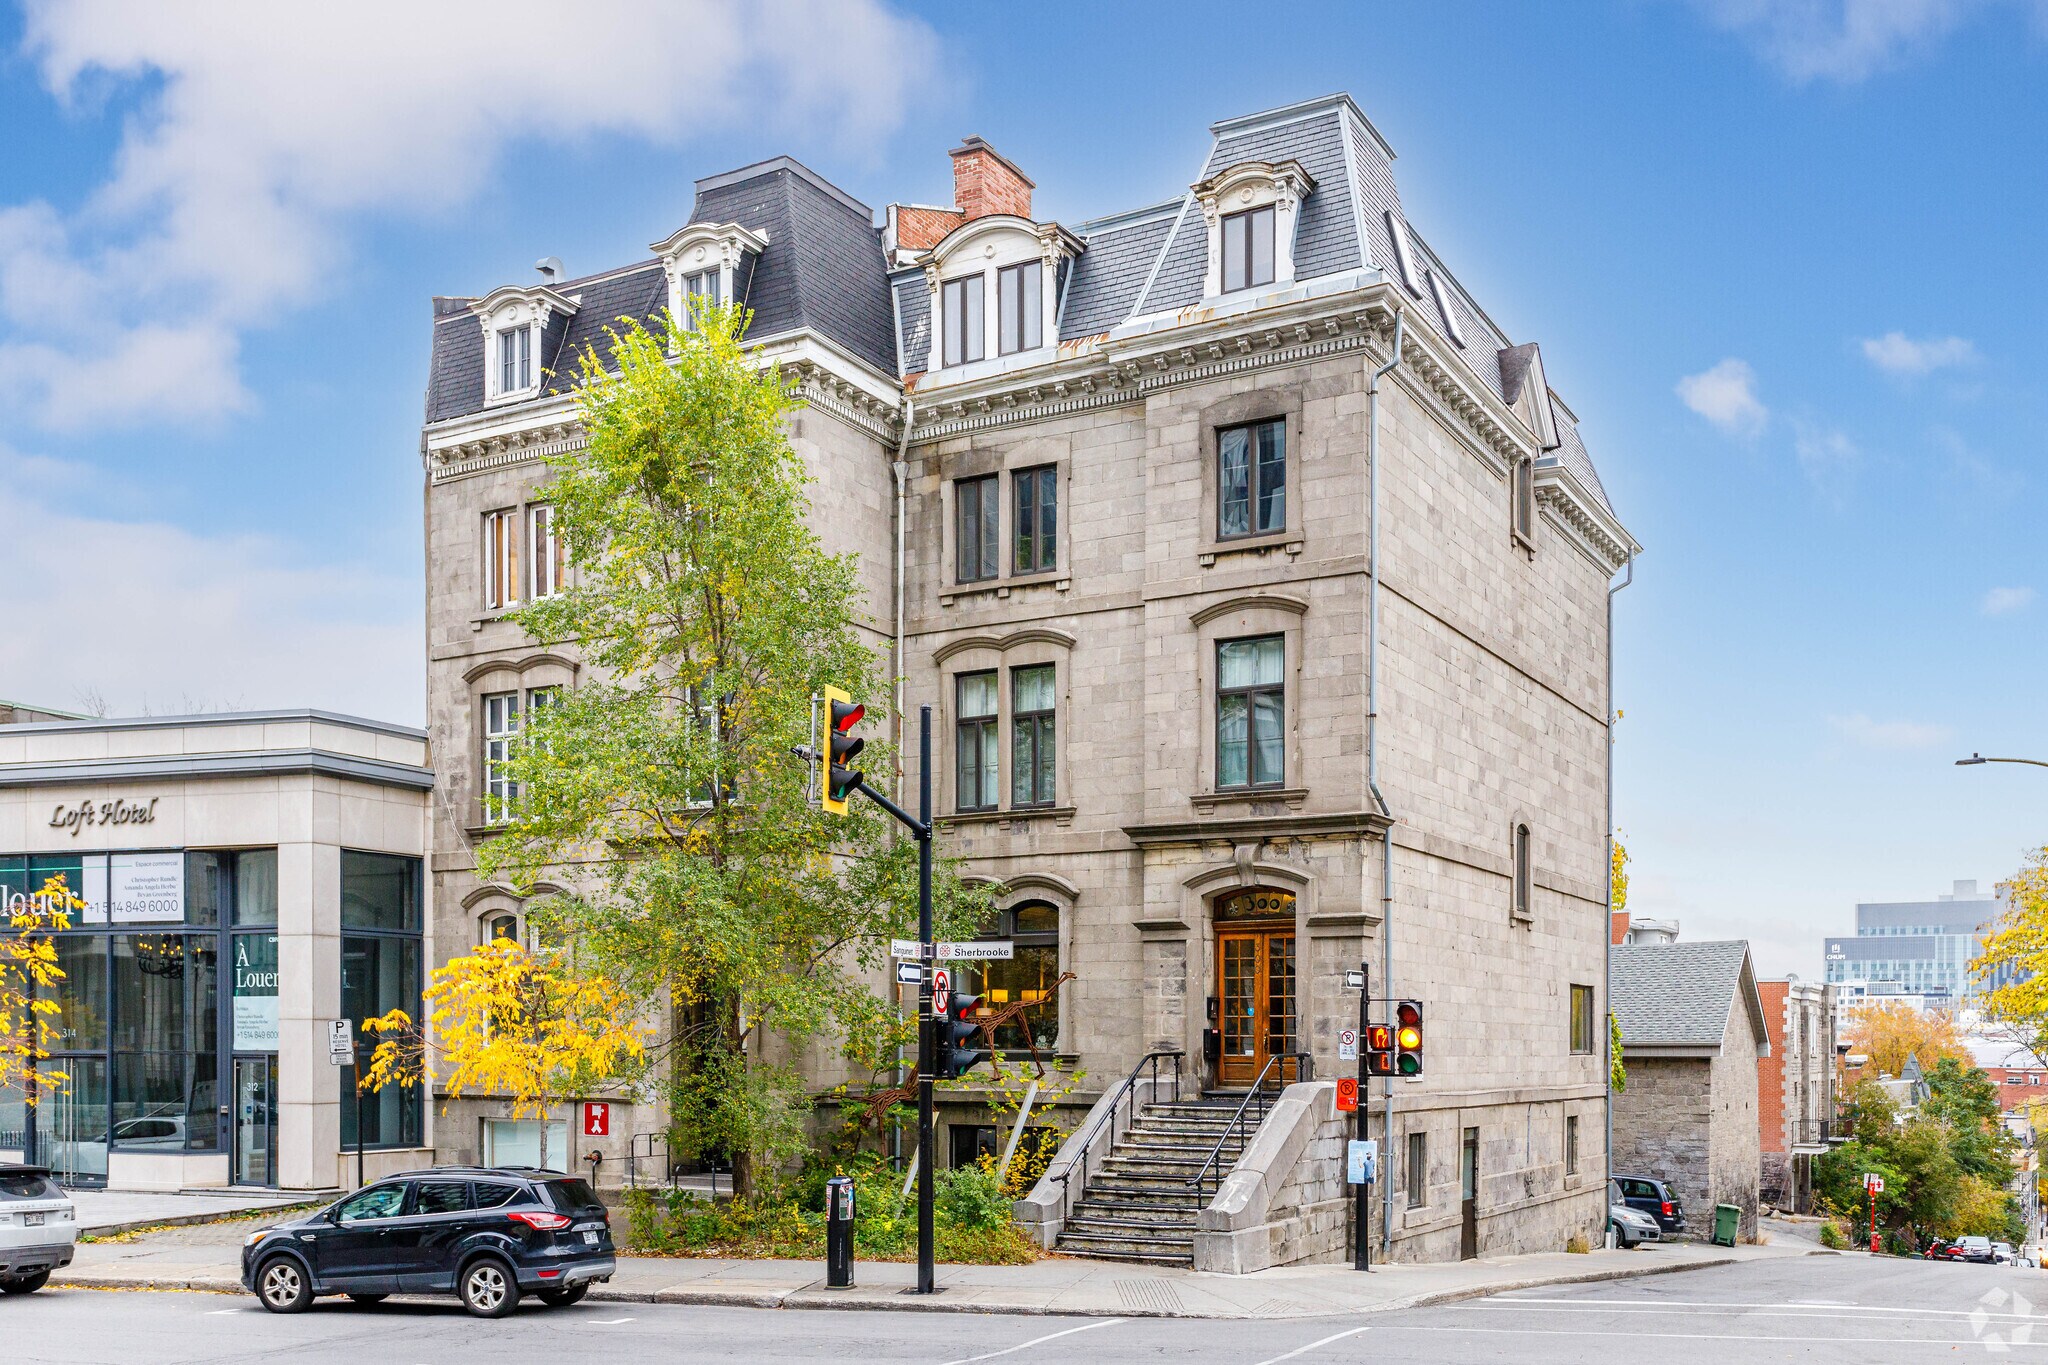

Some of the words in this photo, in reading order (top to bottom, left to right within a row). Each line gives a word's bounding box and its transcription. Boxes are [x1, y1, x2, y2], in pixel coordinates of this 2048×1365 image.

[48, 799, 96, 837] Loft
[98, 797, 159, 825] Hotel
[88, 902, 99, 913] +1
[102, 901, 123, 914] 514
[125, 900, 147, 913] 849
[148, 899, 179, 912] 6000
[1245, 895, 1281, 911] 300
[236, 942, 250, 967] À
[893, 945, 914, 957] Sanguinet
[954, 947, 1010, 957] Sherbrooke
[236, 968, 279, 988] Louer
[62, 1028, 77, 1038] 314
[335, 1021, 345, 1034] P
[246, 1082, 259, 1092] 312
